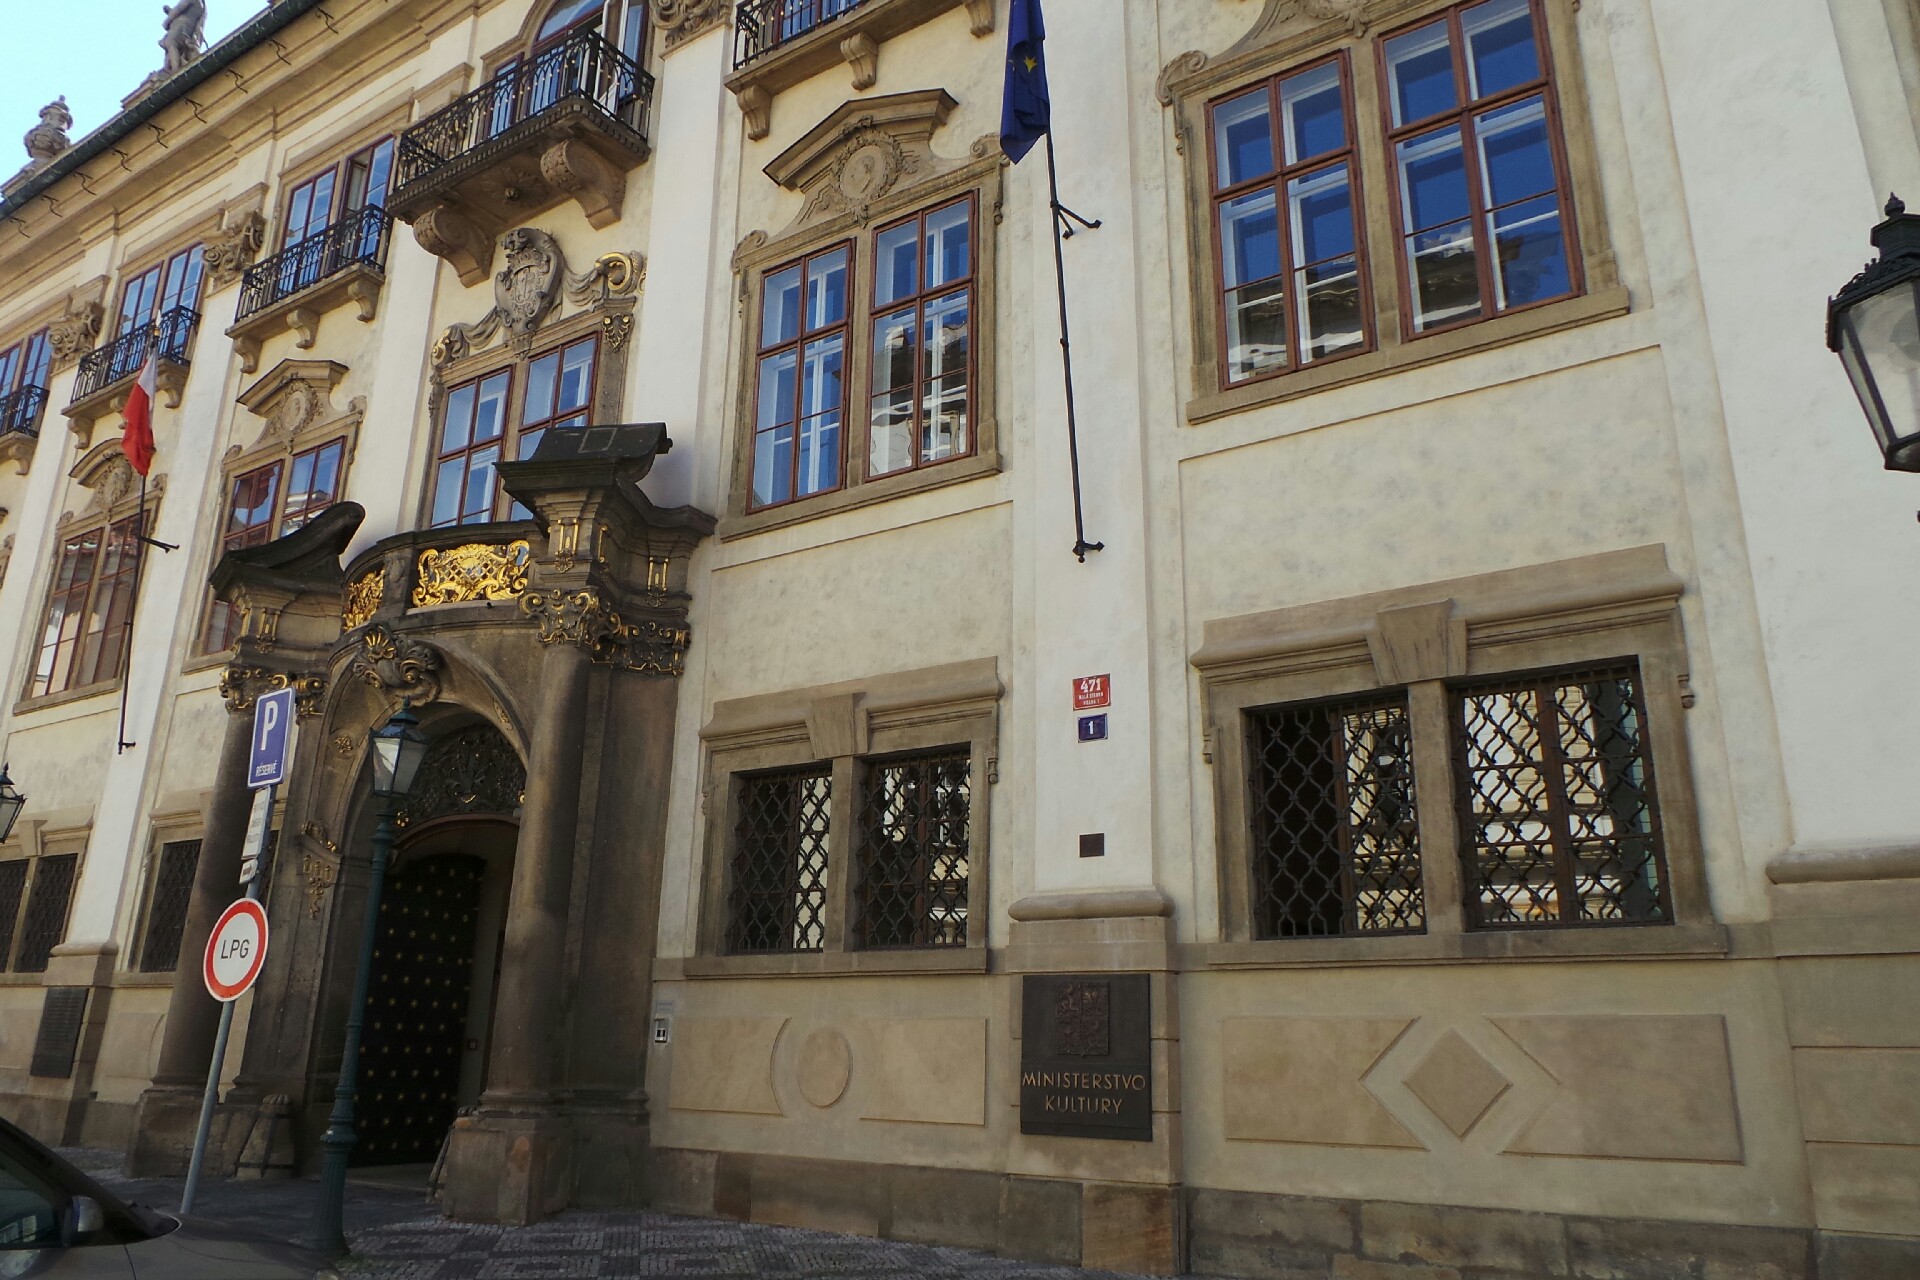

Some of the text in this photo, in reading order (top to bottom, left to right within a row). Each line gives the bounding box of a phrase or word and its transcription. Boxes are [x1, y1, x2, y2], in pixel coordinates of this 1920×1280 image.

[1080, 678, 1101, 693] 471
[260, 700, 278, 751] P
[1088, 720, 1094, 735] 1
[220, 938, 250, 960] LPG
[1021, 1071, 1146, 1091] MINISTERSTVO
[1045, 1094, 1123, 1115] KULTURY
